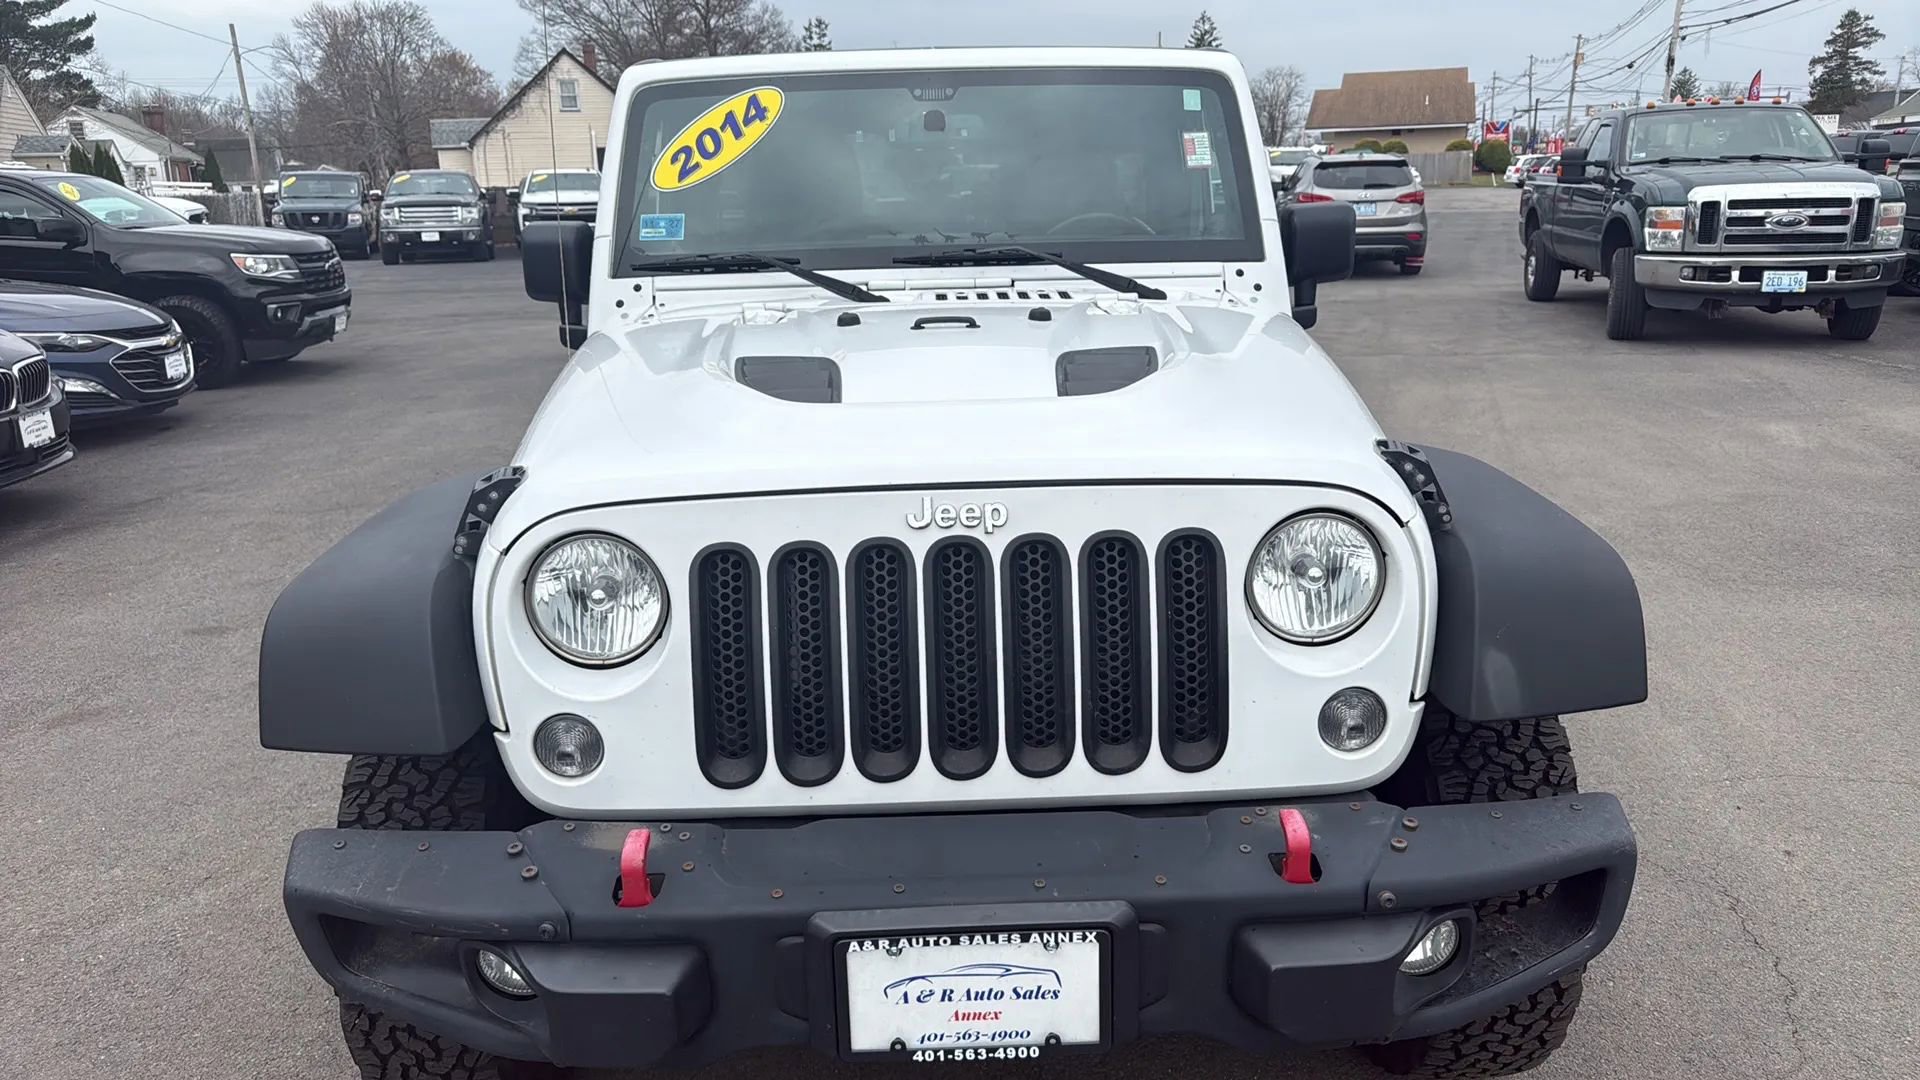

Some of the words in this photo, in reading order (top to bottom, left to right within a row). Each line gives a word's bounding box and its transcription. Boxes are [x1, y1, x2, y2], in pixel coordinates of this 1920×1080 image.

[670, 93, 768, 183] 2014
[1787, 276, 1804, 287] 196
[905, 496, 1008, 534] Jeep
[848, 939, 890, 952] A&R
[898, 937, 951, 949] AUTO
[959, 934, 1022, 946] SALES
[1029, 931, 1097, 944] ANNEX
[896, 990, 909, 1004] A
[916, 989, 935, 1003] &
[940, 988, 955, 1002] R
[958, 988, 1004, 1003] Auto
[1009, 985, 1060, 1001] Sales
[948, 1009, 1002, 1023] Annex
[917, 1029, 1031, 1045] 401-563-4900
[912, 1046, 1040, 1062] 401-563-4900
